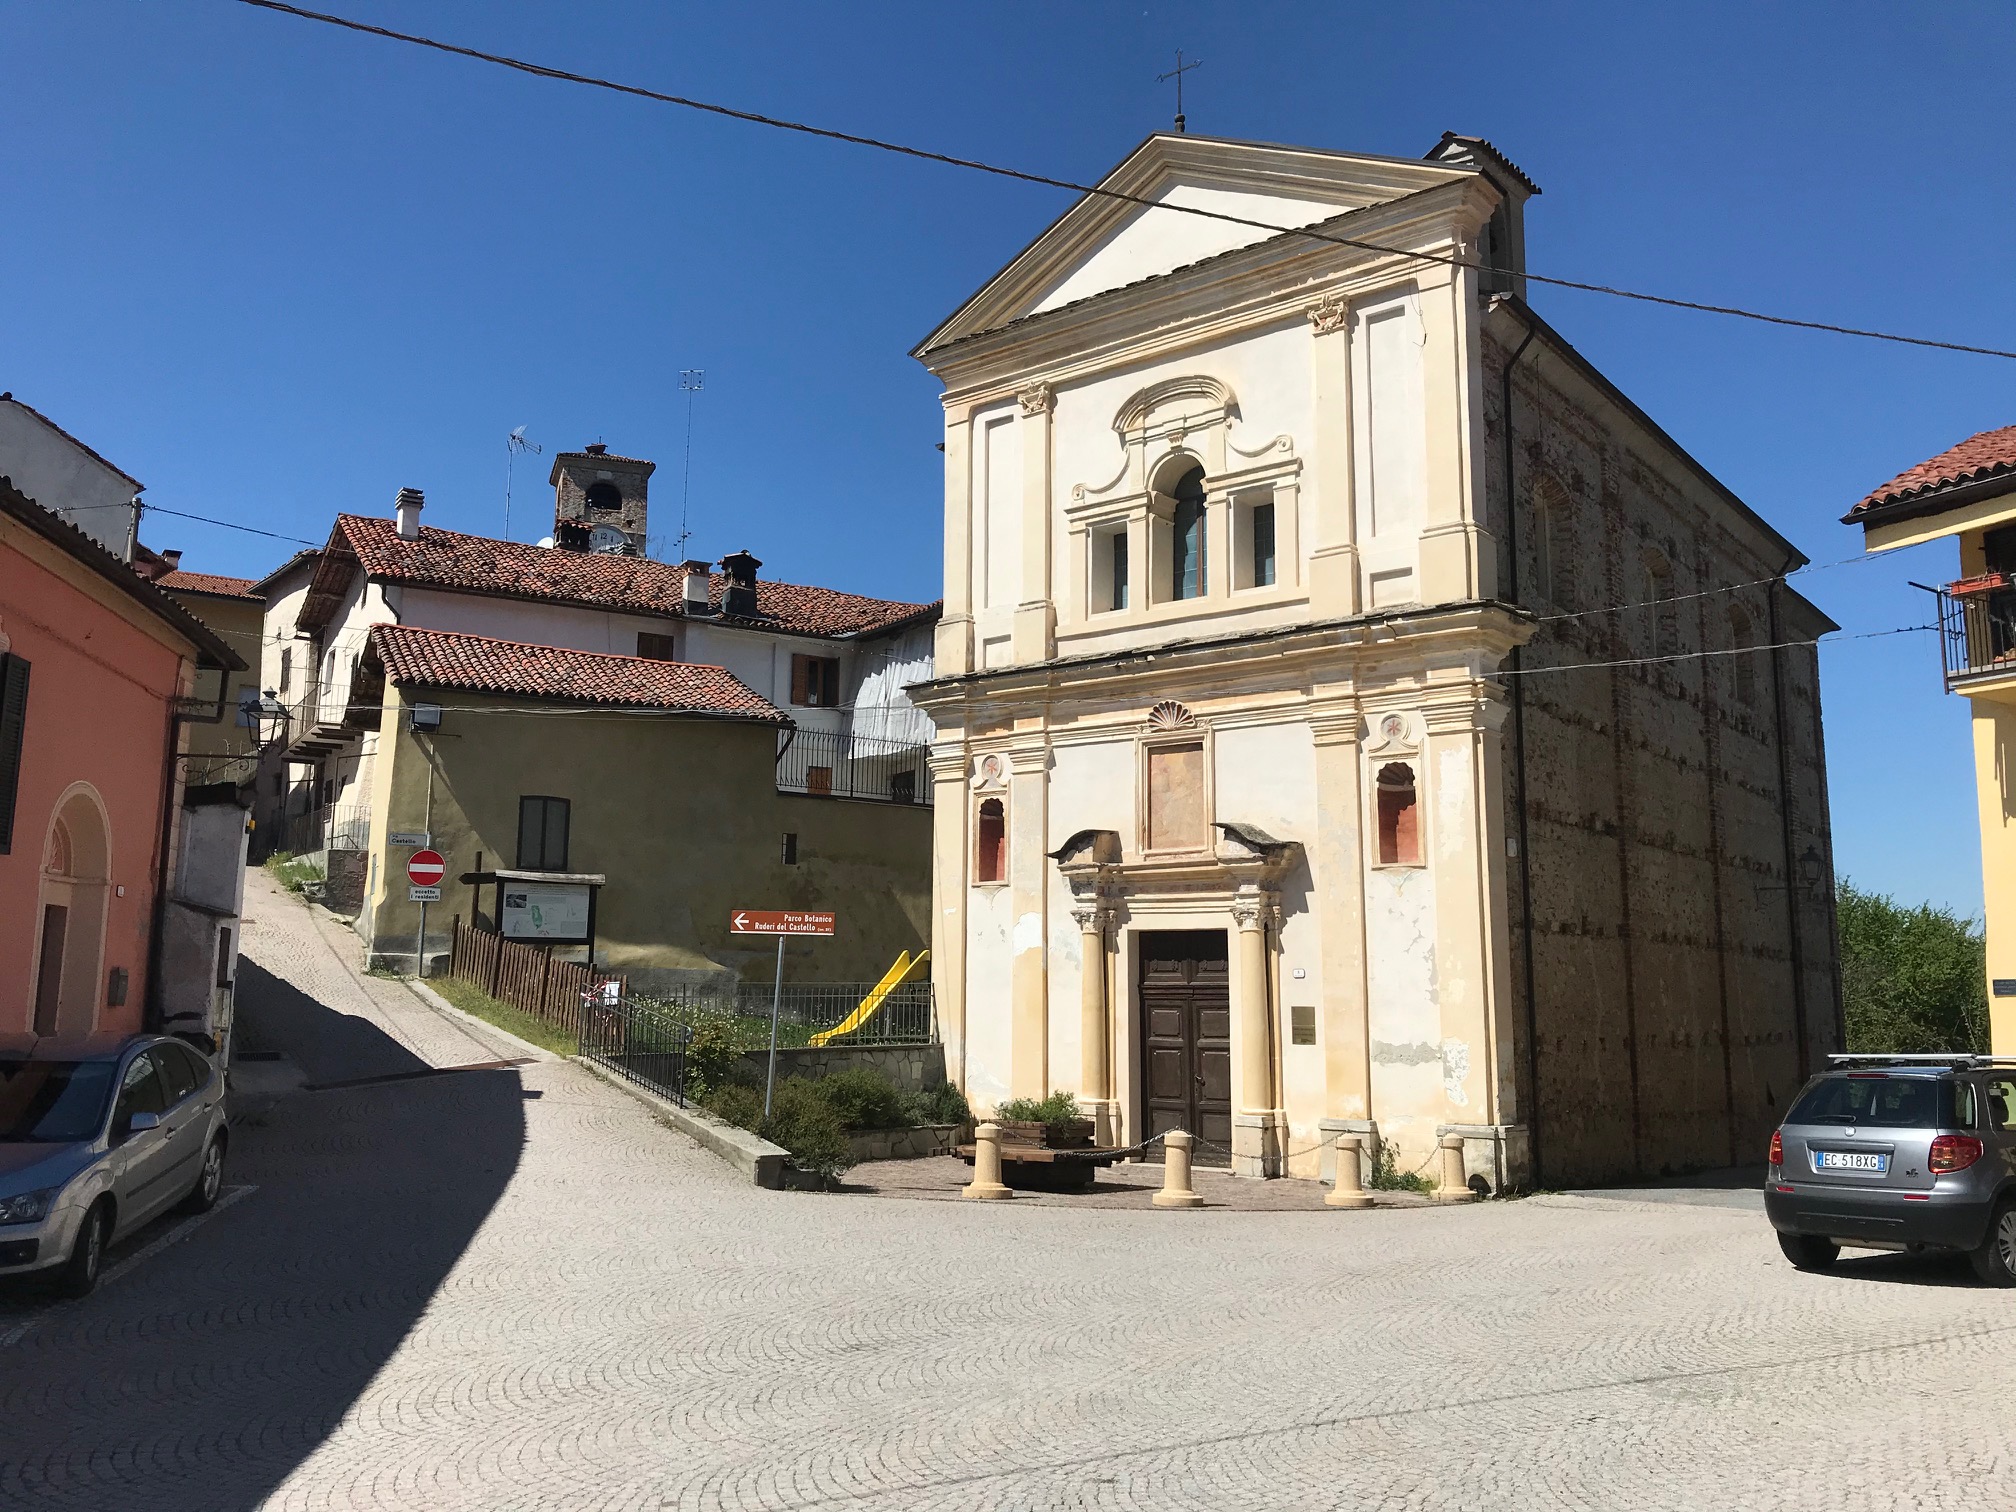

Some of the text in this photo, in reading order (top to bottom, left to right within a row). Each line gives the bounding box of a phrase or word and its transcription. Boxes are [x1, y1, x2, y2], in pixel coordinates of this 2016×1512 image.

[600, 532, 608, 540] 12
[784, 913, 833, 923] Parco Botanico
[754, 922, 775, 930] Ruderi
[776, 922, 788, 931] del
[789, 922, 816, 932] Castello
[1824, 1153, 1838, 1166] EC
[1841, 1154, 1877, 1168] 518XG
